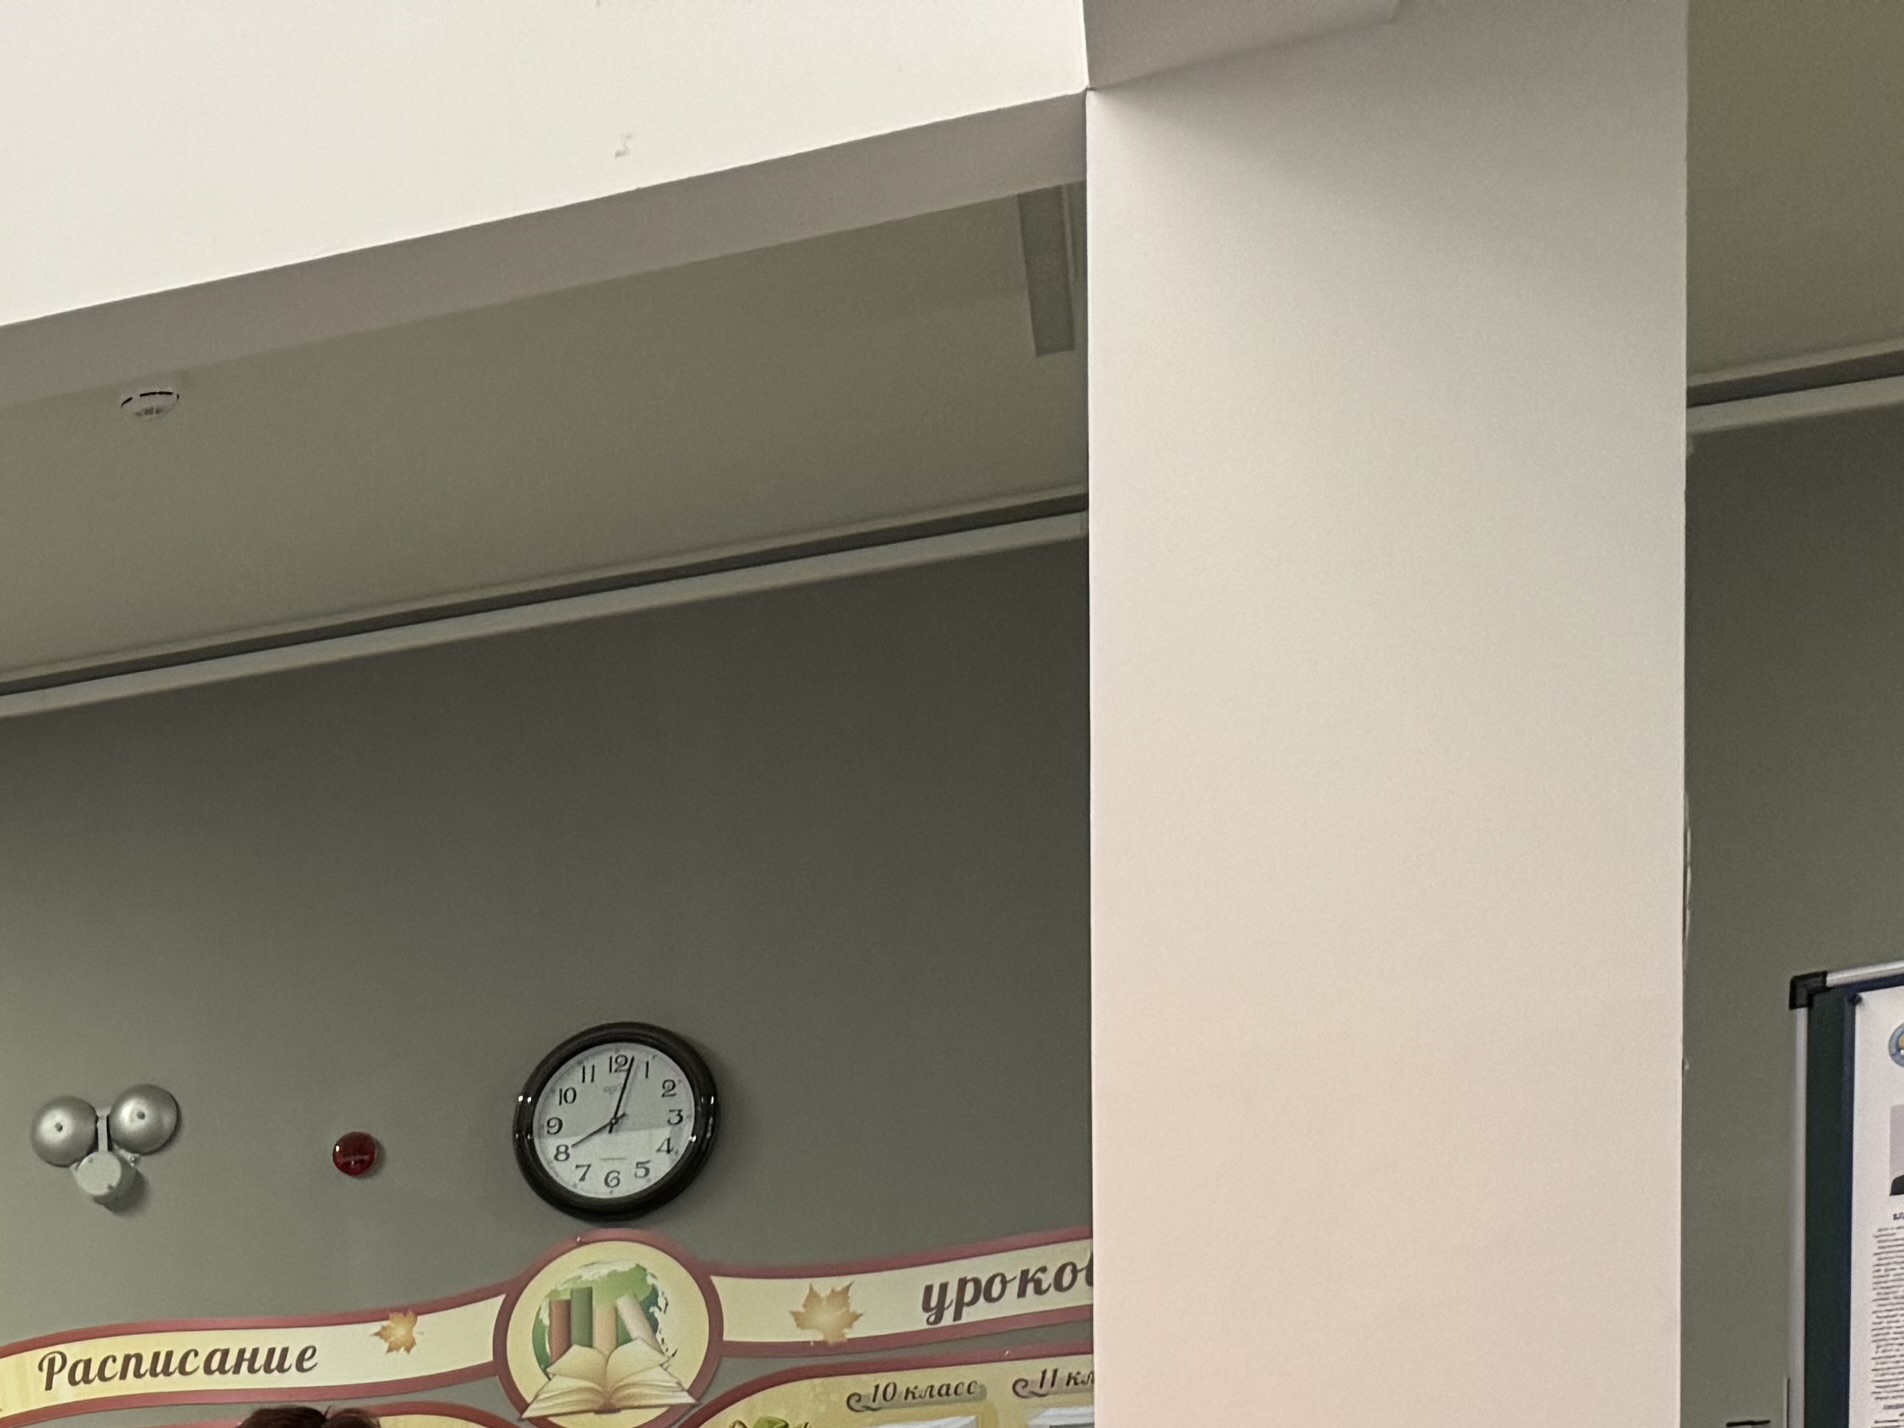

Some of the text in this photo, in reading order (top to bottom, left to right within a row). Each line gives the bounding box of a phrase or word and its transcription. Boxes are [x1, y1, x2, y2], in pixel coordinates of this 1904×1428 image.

[581, 1064, 596, 1083] 11
[608, 1055, 629, 1073] 12
[644, 1060, 650, 1079] 1
[558, 1087, 577, 1105] 10
[661, 1079, 677, 1098] 2
[546, 1117, 564, 1135] 9
[667, 1109, 684, 1126] 3
[553, 1144, 571, 1162] 8
[655, 1137, 675, 1155] 4
[575, 1163, 592, 1182] 7
[604, 1170, 621, 1188] 6
[634, 1160, 652, 1179] 5
[37, 1344, 319, 1391] Расписание
[1038, 1367, 1059, 1389] 11
[872, 1380, 978, 1403] 10 класс
